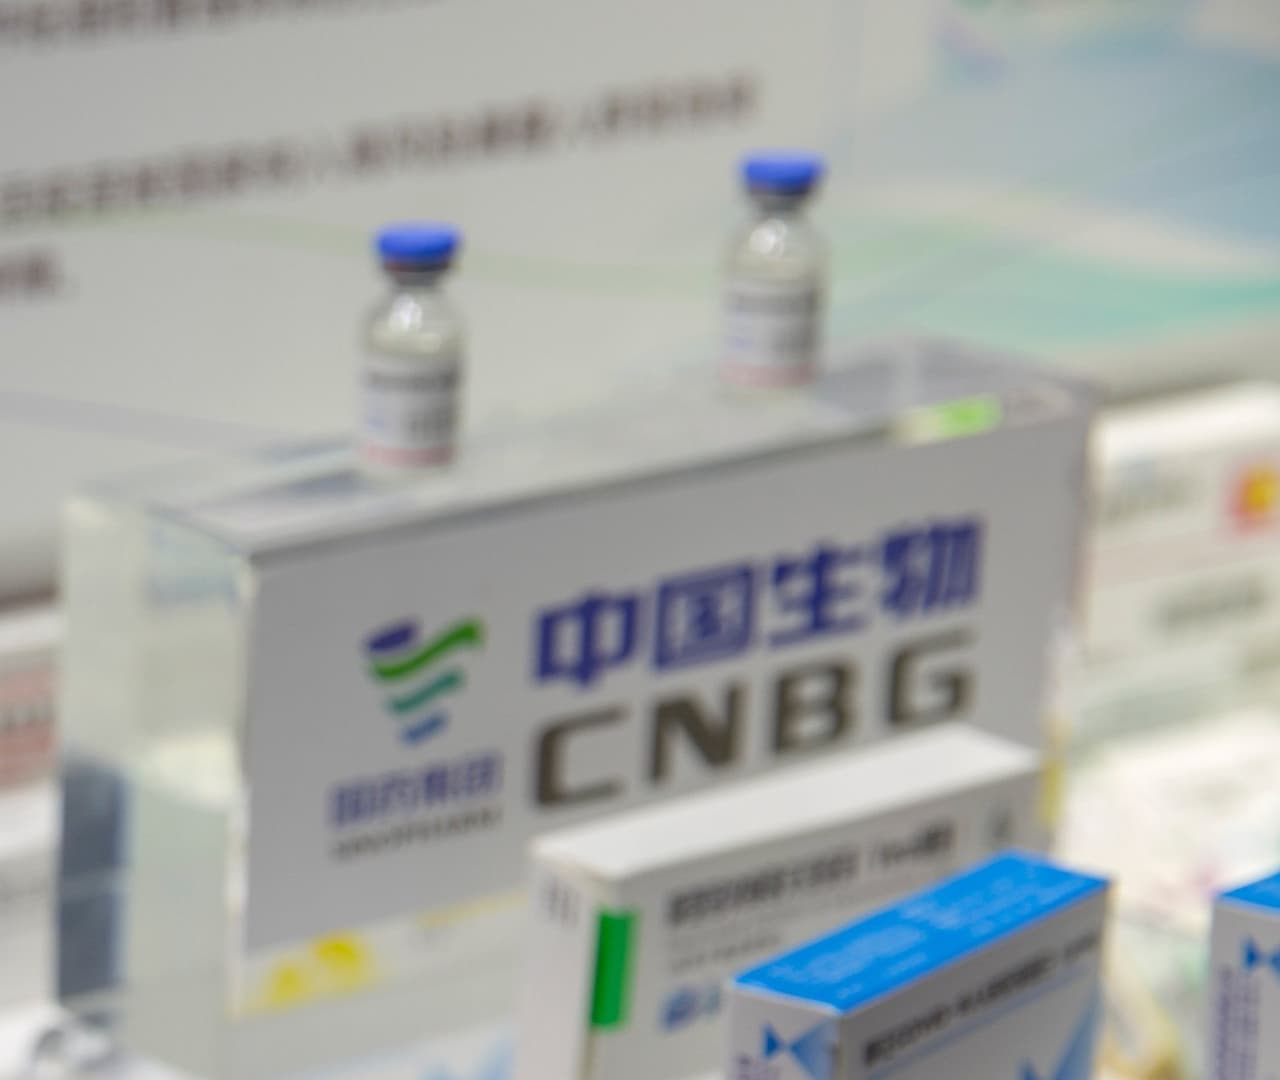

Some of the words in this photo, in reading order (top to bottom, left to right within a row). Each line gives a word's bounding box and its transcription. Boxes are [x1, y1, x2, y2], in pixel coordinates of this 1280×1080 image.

[532, 515, 985, 688] 中国生物
[535, 630, 977, 808] CNBG
